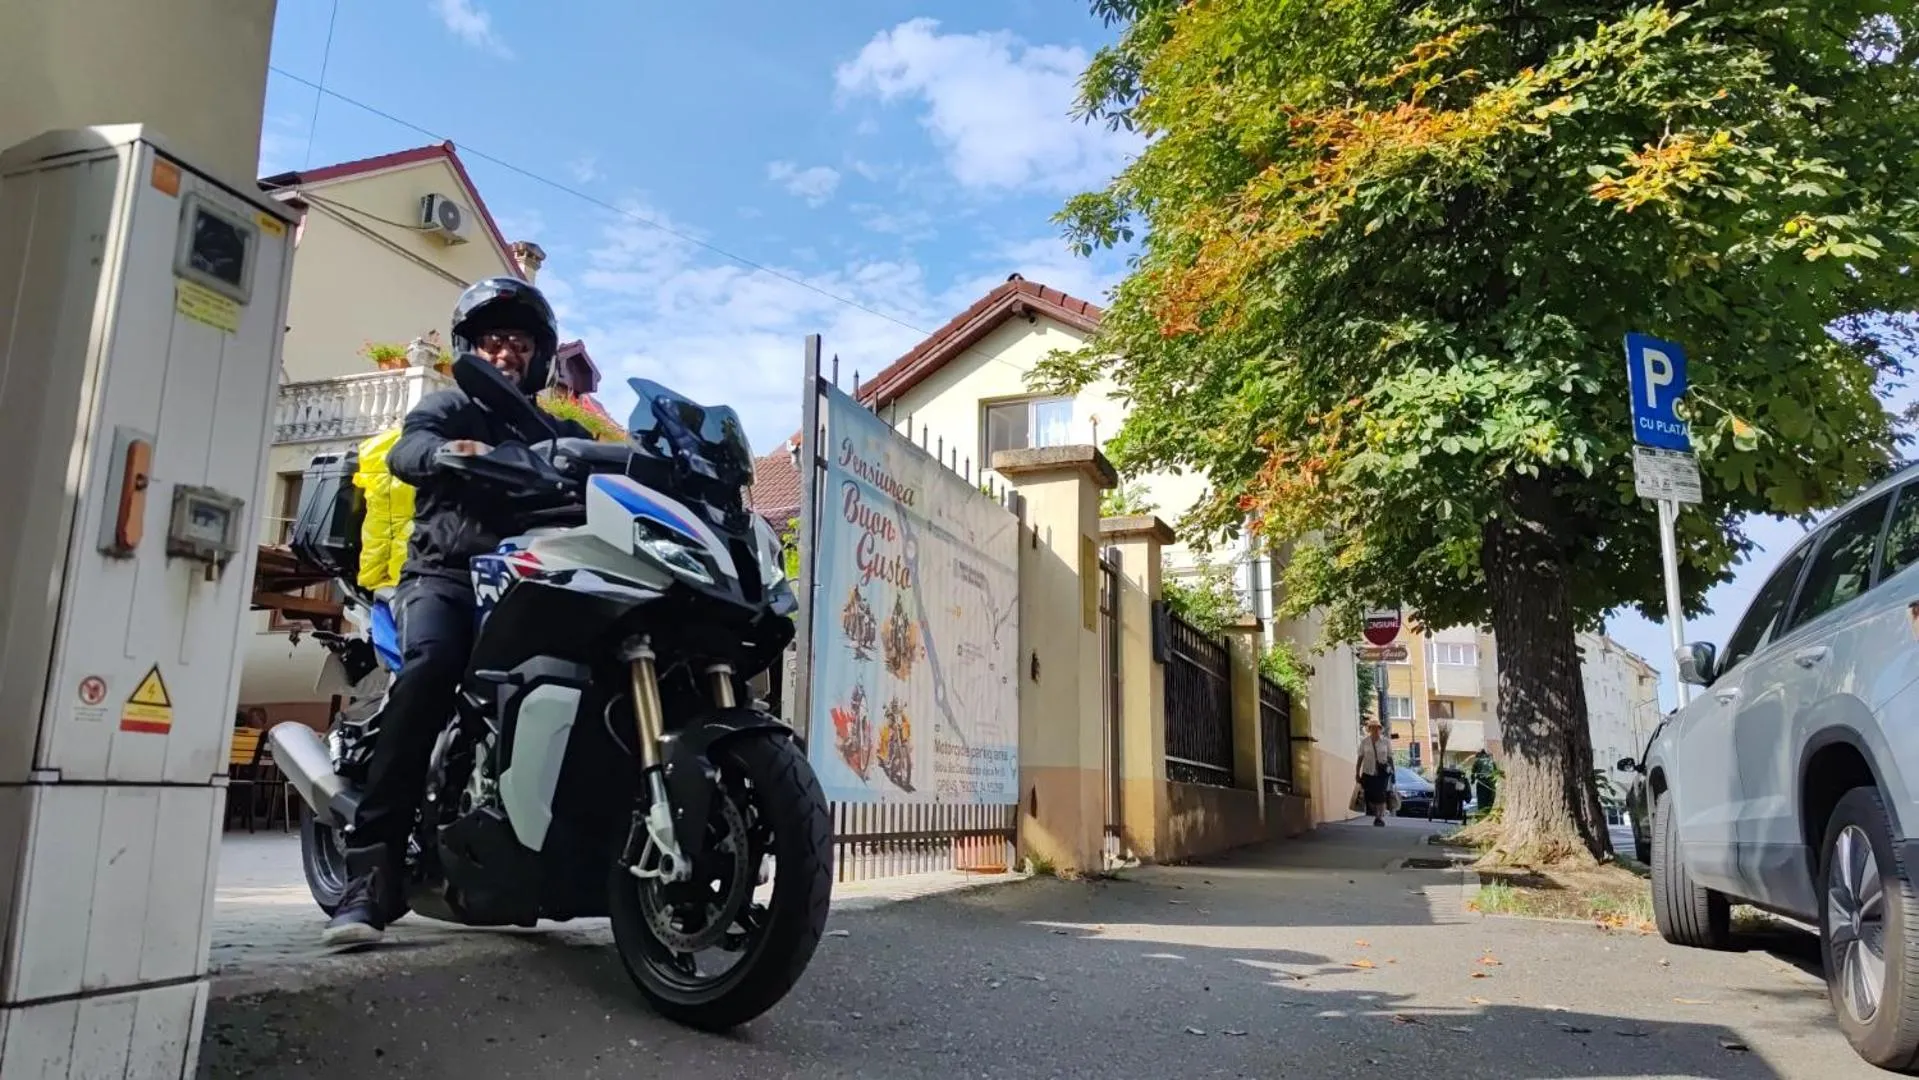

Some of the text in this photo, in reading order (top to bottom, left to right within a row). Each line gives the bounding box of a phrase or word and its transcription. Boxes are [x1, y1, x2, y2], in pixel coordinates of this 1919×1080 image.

[1643, 347, 1674, 409] P
[1640, 417, 1653, 431] CU
[839, 437, 915, 506] Pensiunea
[842, 479, 896, 541] Buon
